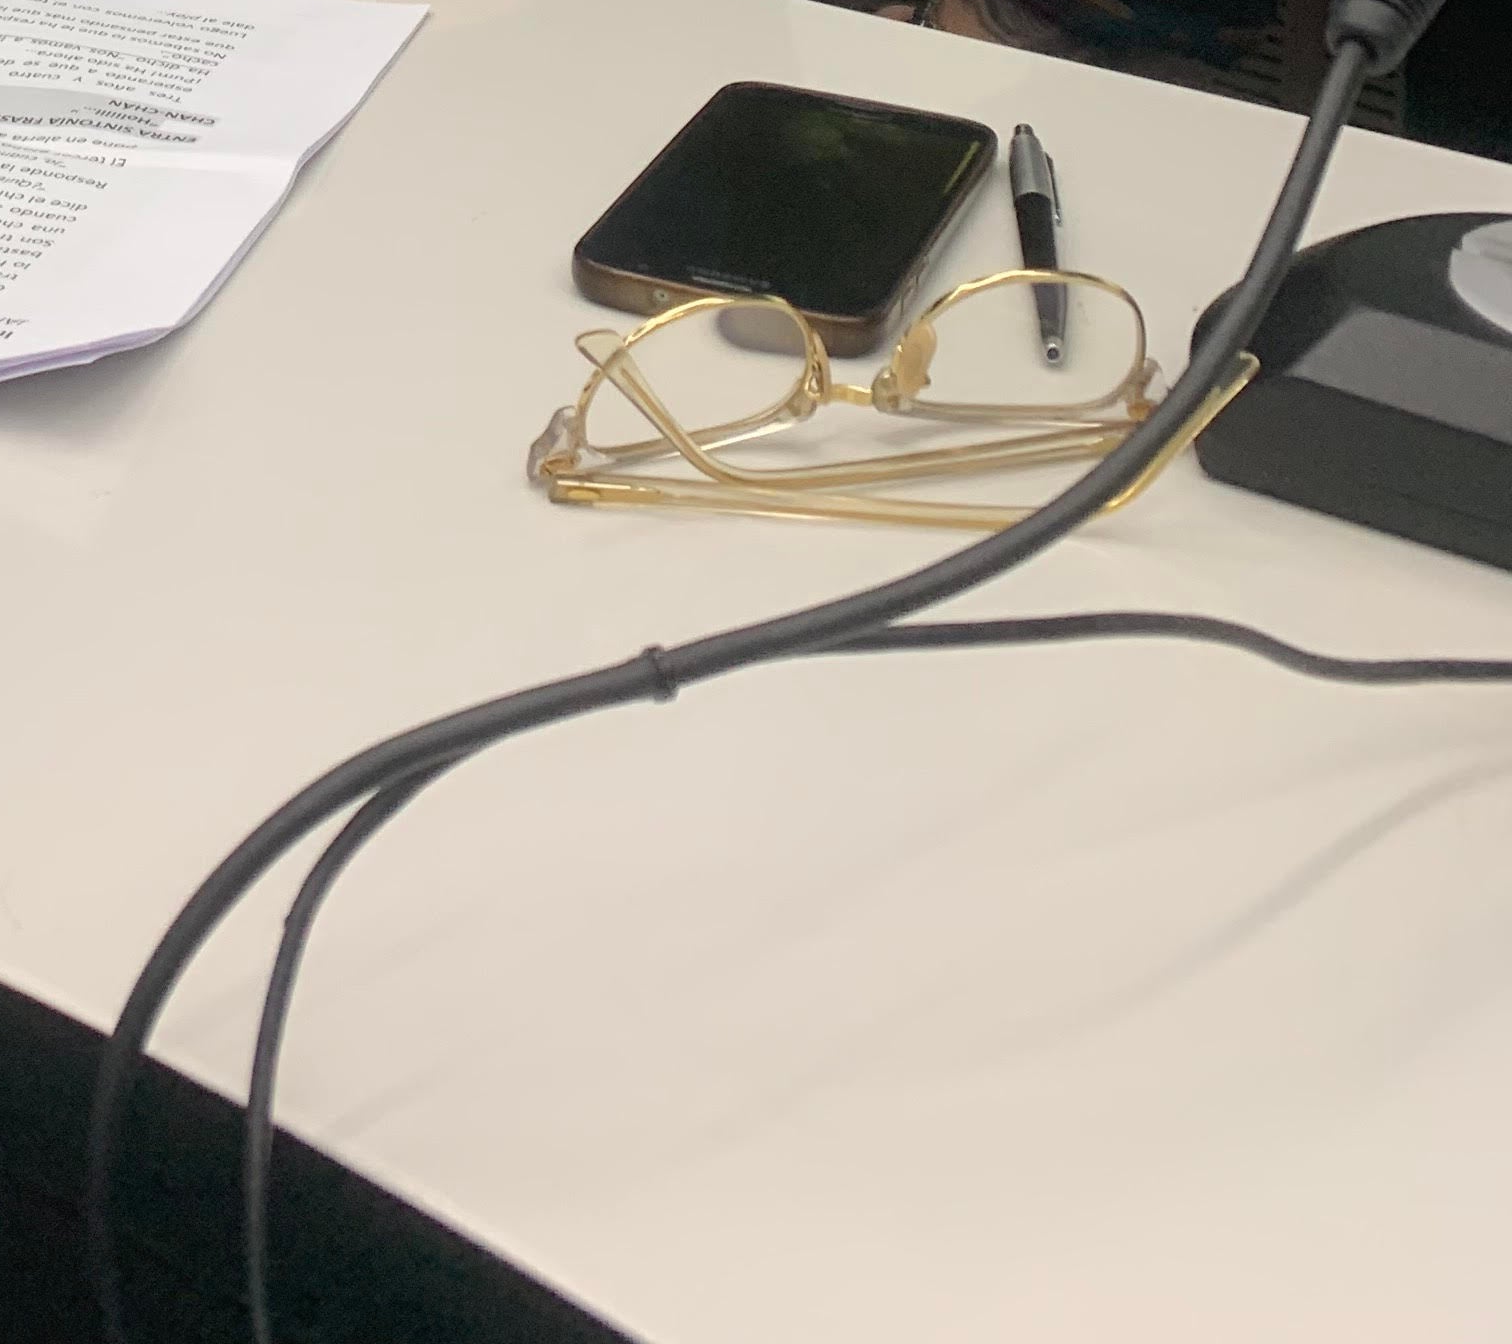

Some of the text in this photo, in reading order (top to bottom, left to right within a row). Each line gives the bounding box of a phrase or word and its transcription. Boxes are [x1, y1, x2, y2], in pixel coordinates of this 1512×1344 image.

[48, 117, 133, 133] SINTONÍA
[139, 128, 196, 142] ENTRA
[0, 163, 15, 172] la
[19, 166, 108, 189] Responde
[27, 195, 46, 203] el
[49, 199, 87, 211] dice
[9, 206, 76, 222] cuando
[30, 224, 65, 233] una
[19, 236, 54, 247] Son
[12, 261, 31, 270] lo
